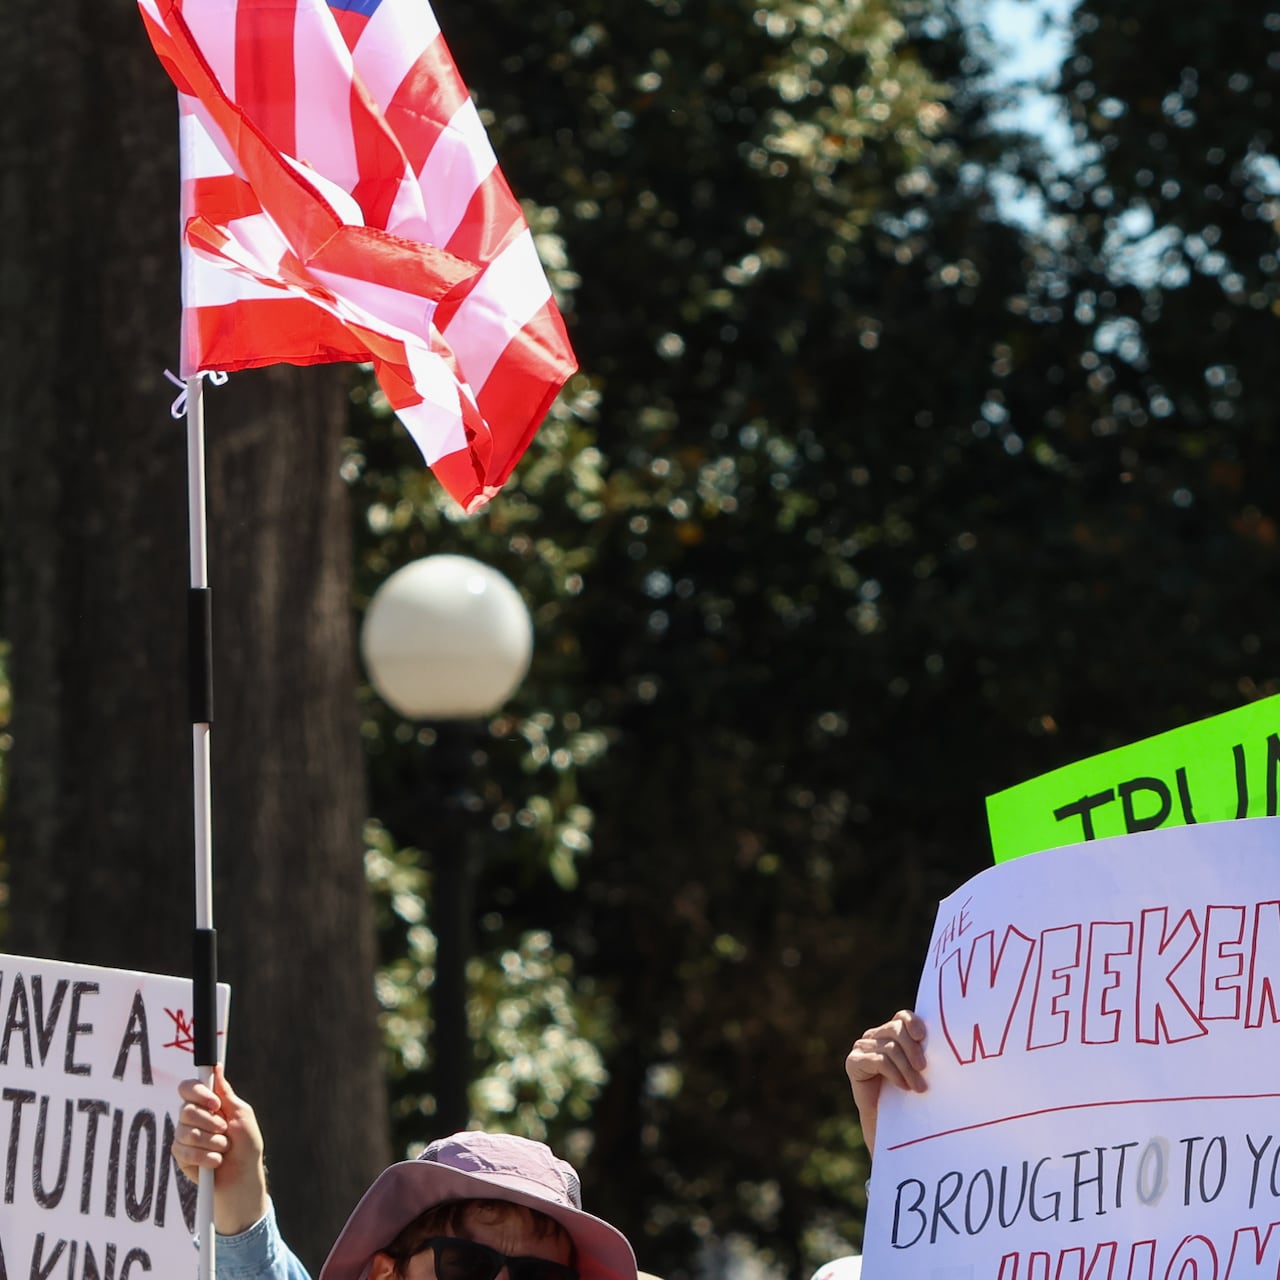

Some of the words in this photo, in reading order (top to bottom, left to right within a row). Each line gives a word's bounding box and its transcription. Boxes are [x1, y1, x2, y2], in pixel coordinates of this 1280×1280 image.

[932, 895, 974, 969] THE
[112, 989, 154, 1086] A
[1179, 1134, 1226, 1207] TO
